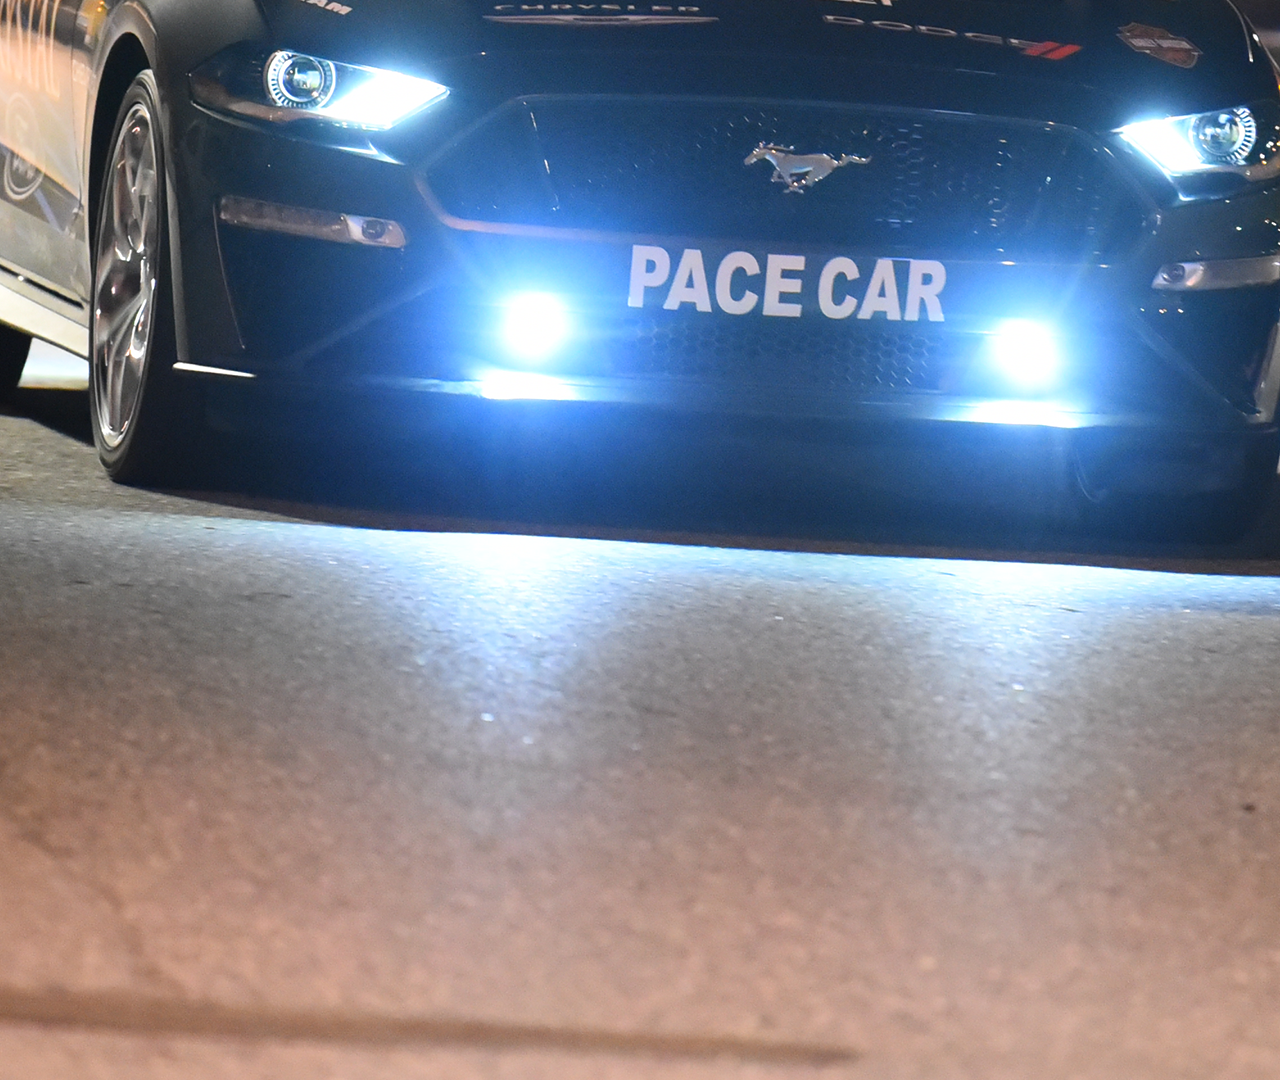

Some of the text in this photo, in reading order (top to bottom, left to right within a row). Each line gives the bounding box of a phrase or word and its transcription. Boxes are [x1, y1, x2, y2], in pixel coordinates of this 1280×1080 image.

[822, 15, 1046, 51] DODGE
[627, 244, 947, 322] PACE CAR
